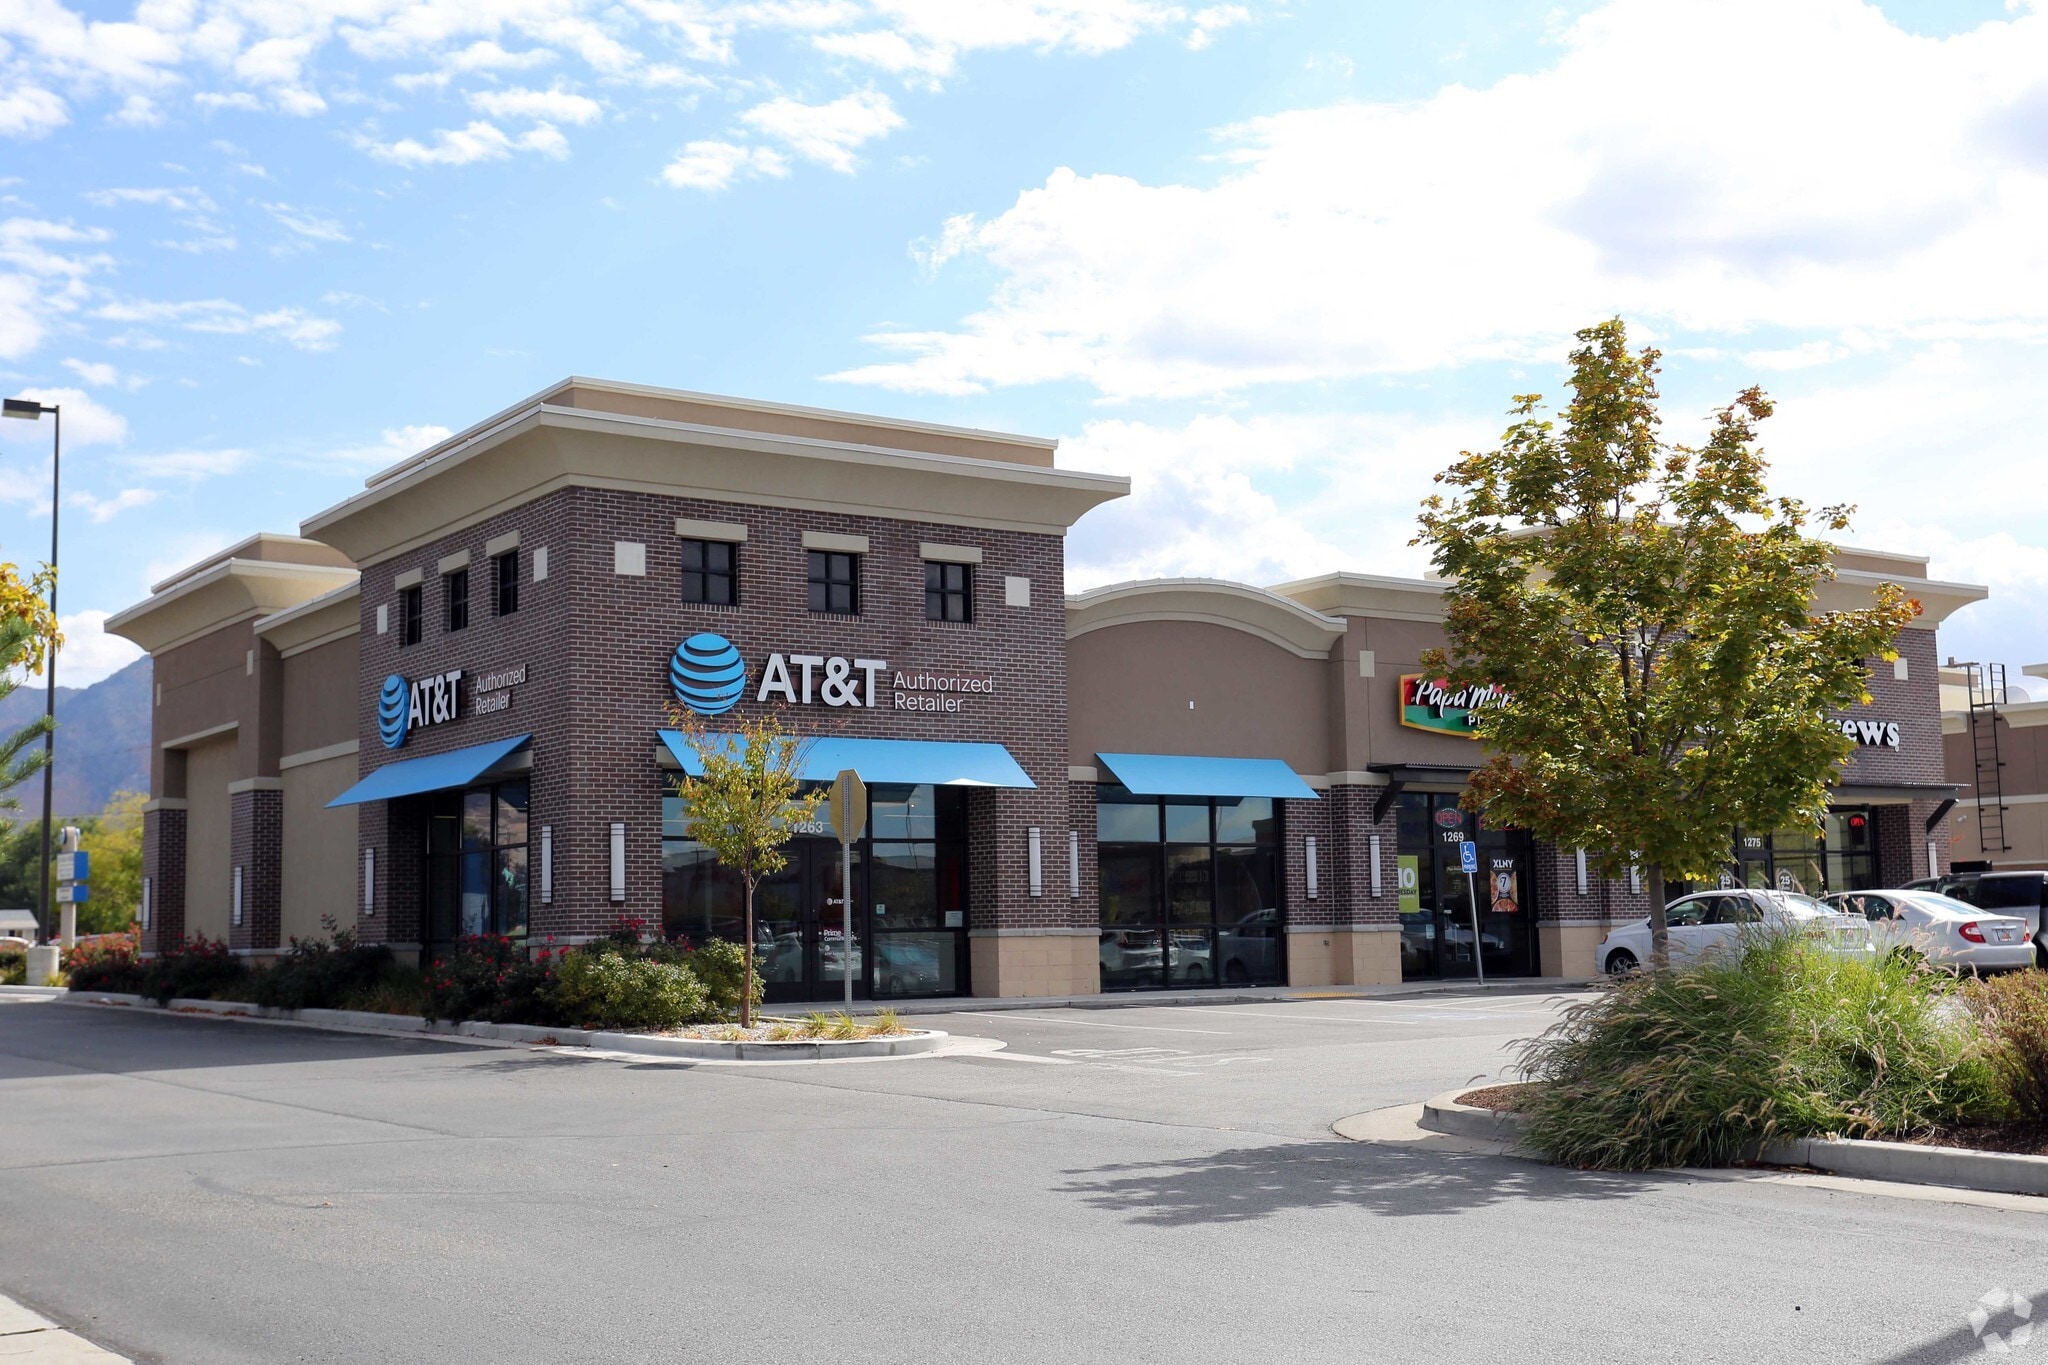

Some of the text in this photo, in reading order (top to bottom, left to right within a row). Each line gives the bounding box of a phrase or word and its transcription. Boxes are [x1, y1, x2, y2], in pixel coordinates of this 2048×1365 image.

[475, 663, 527, 694] Authorized
[757, 653, 887, 708] AT&T
[892, 671, 994, 694] Authorized
[408, 669, 464, 730] AT&T
[475, 692, 511, 716] Retailer
[894, 692, 964, 713] Retailer
[1412, 678, 1467, 719] Papa
[793, 821, 824, 833] 1263
[1435, 812, 1463, 824] OPEN
[1442, 831, 1464, 842] 1269
[1743, 837, 1761, 848] 1275
[1492, 859, 1514, 869] XLNY
